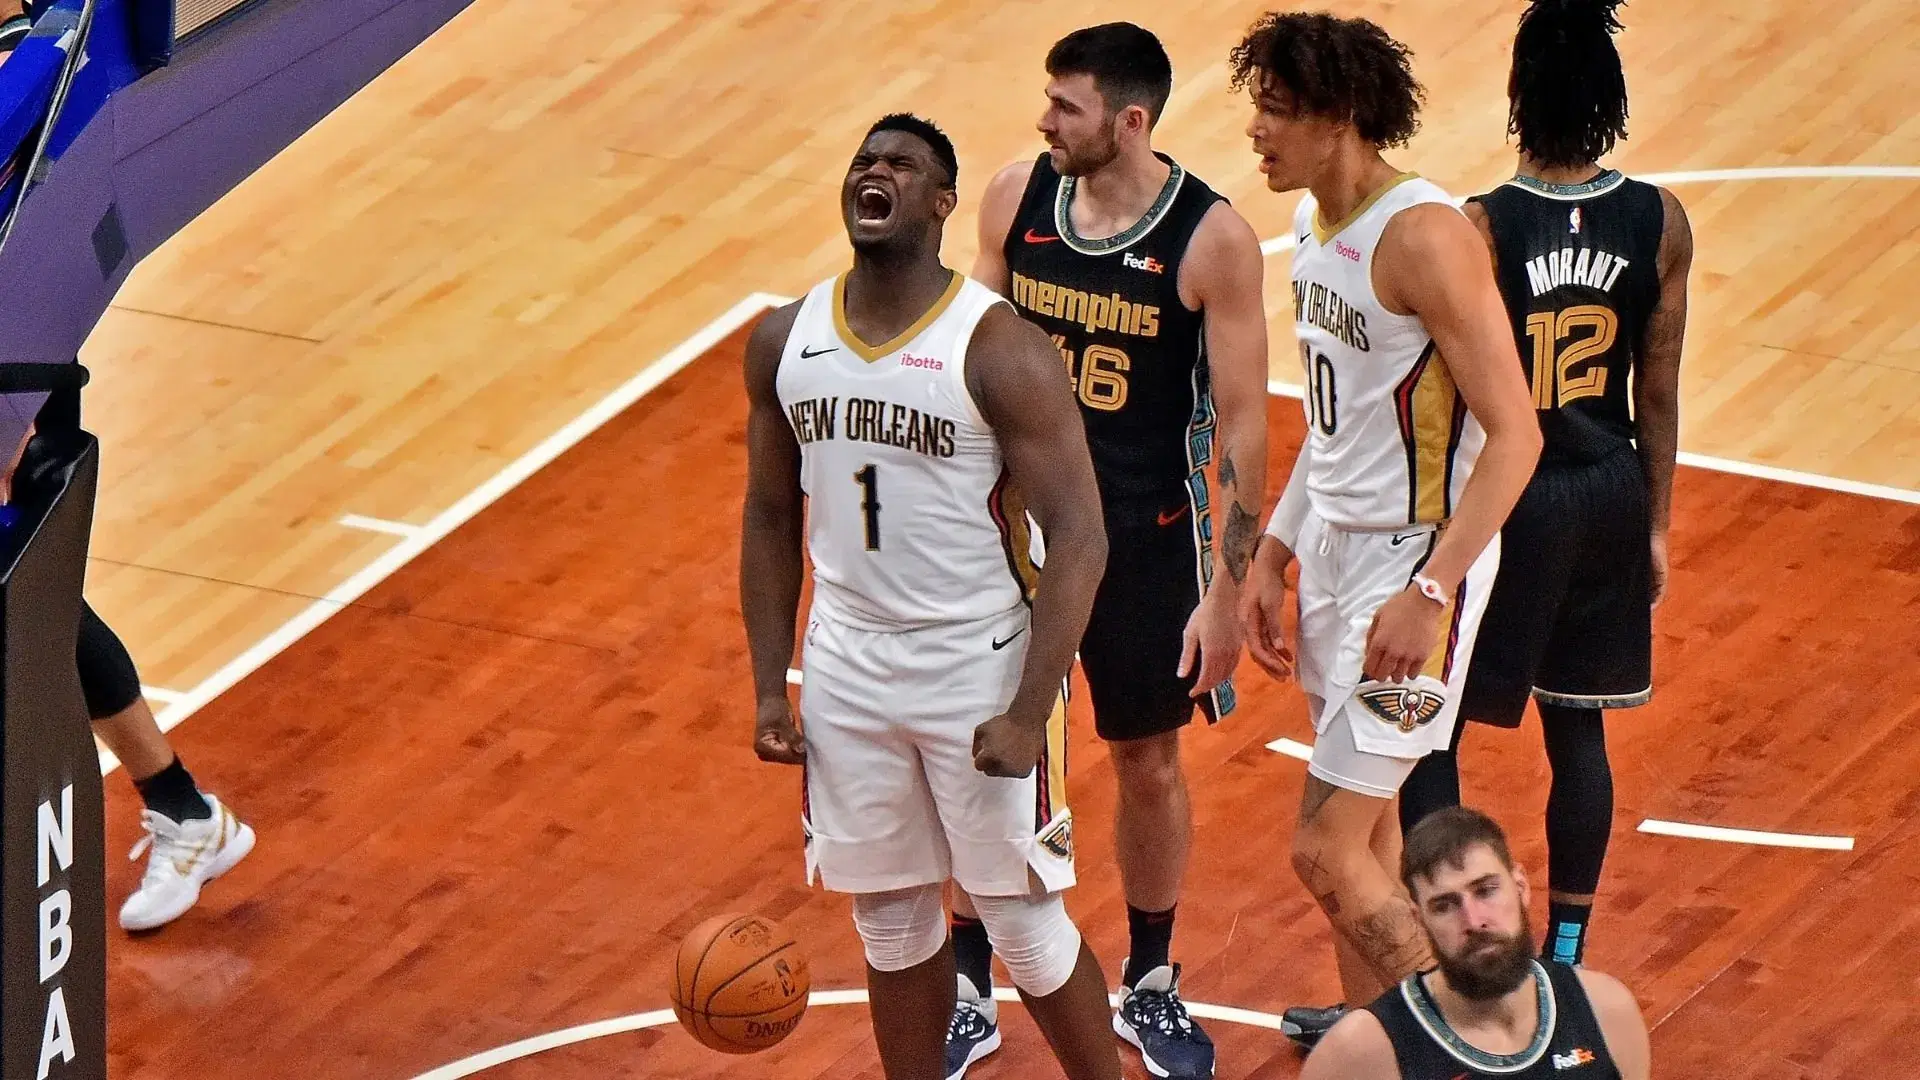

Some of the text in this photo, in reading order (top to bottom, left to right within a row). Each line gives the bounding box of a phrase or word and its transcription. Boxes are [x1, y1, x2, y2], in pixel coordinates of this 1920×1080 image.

[1122, 252, 1165, 275] FedEx
[1335, 240, 1361, 262] ibotta
[1525, 248, 1630, 297] MORANT
[1012, 271, 1161, 337] memphis
[1307, 281, 1371, 353] ORLEANS
[900, 353, 944, 371] ibotta
[1525, 304, 1618, 410] 12
[844, 397, 956, 459] ORLEANS
[852, 463, 882, 552] 1
[37, 783, 75, 1080] NBA
